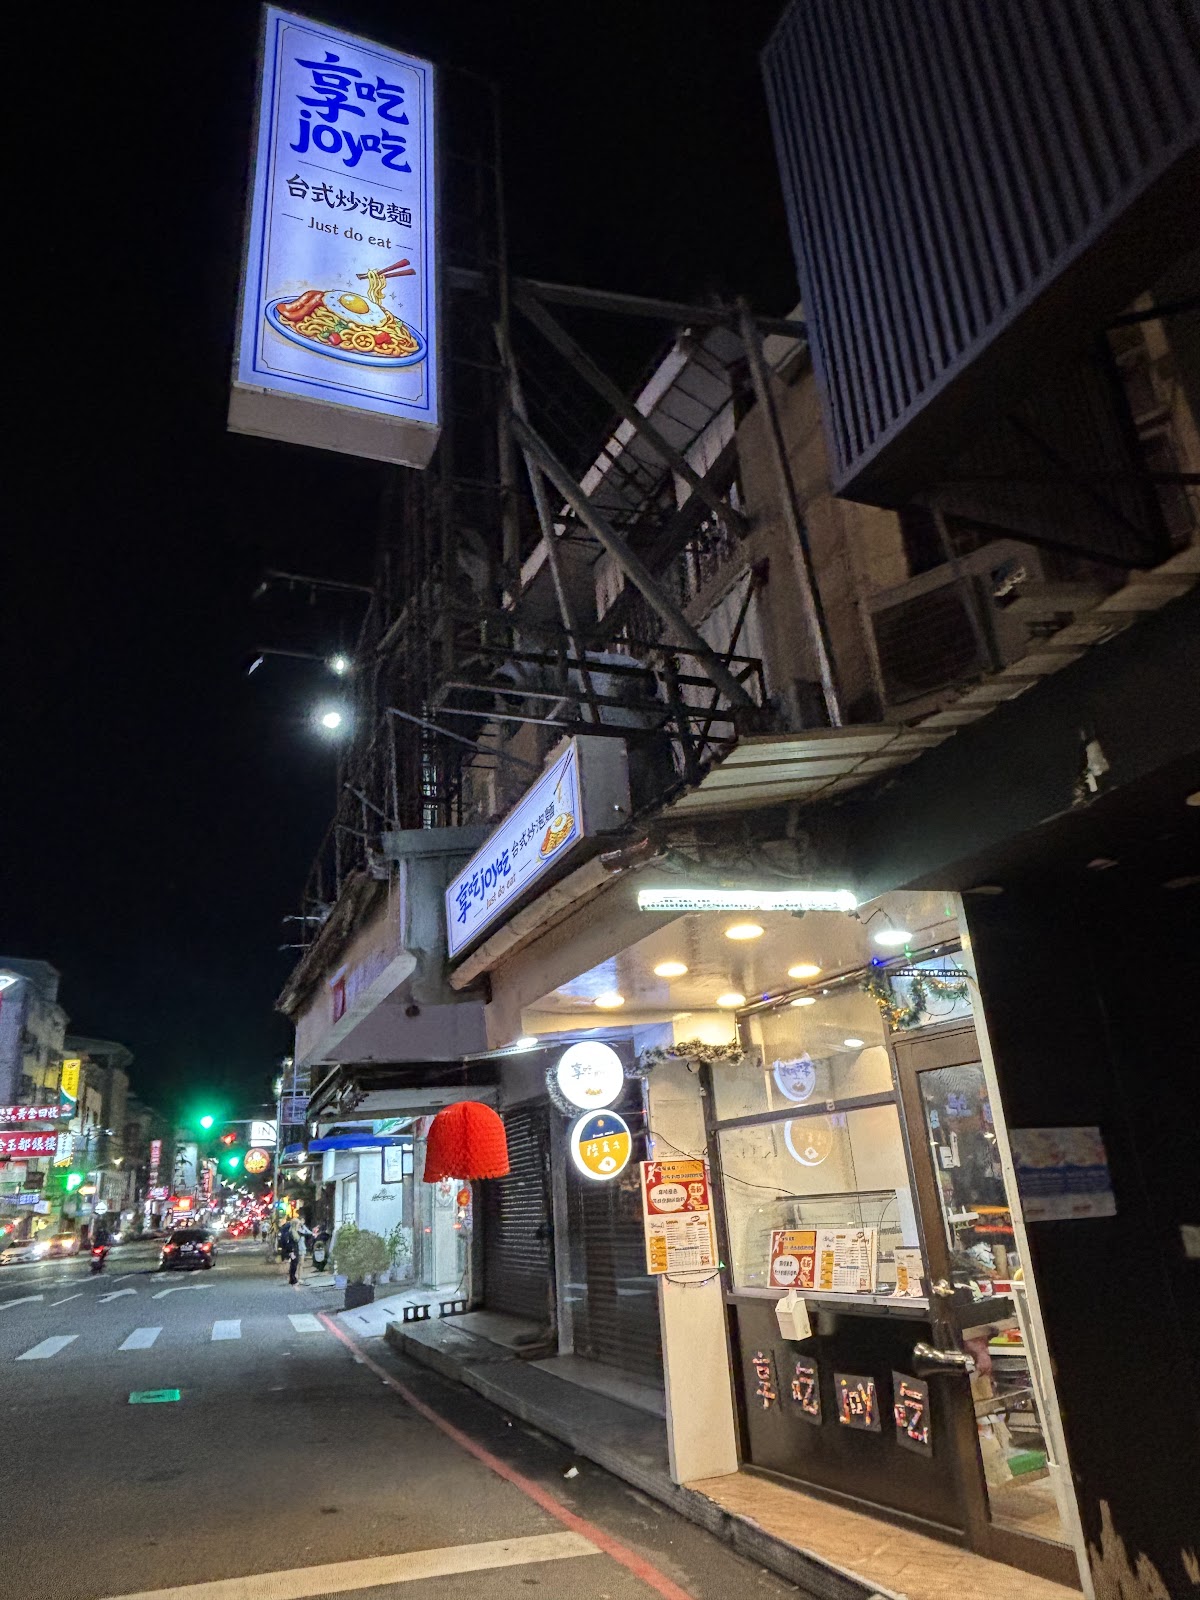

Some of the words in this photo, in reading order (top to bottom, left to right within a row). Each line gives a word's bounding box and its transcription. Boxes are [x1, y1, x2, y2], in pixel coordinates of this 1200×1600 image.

[294, 51, 410, 125] 享吃
[289, 109, 412, 173] joy吃
[286, 174, 412, 229] 台式炒泡麵
[308, 217, 339, 235] Just
[343, 227, 363, 242] do
[368, 236, 392, 249] eat
[511, 801, 555, 858] 台式炒泡麵
[17, 1106, 59, 1119] 黃金回收
